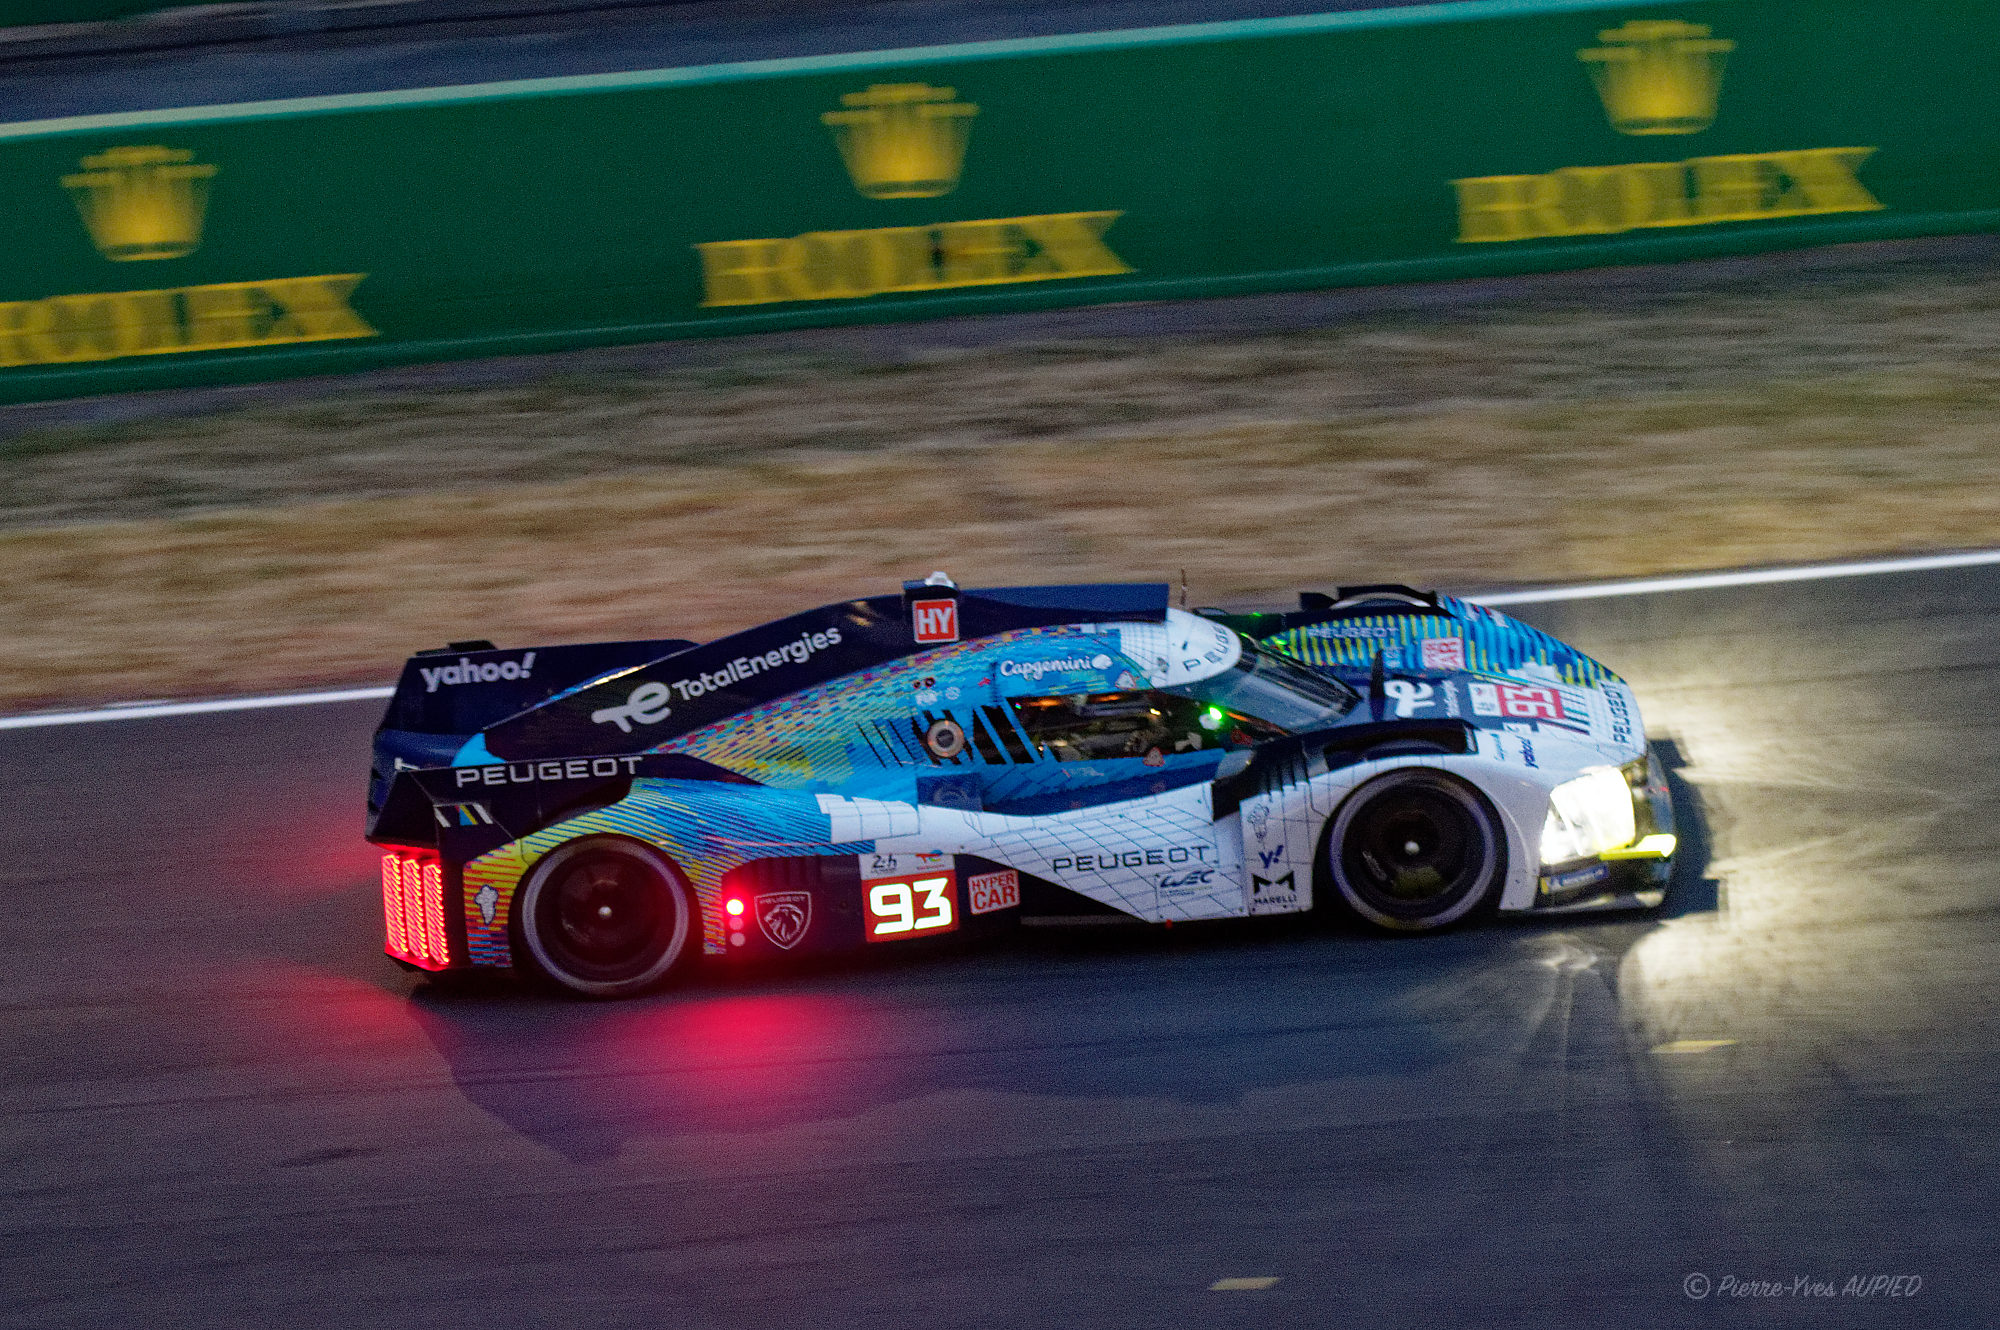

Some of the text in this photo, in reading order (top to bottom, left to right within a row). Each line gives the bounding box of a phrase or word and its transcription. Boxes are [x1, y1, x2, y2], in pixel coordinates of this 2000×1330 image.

[917, 606, 953, 635] HY
[419, 651, 537, 693] yahoo!
[671, 627, 842, 701] TotalEnergies
[1000, 655, 1092, 681] Capgemini
[1501, 686, 1559, 718] 93
[456, 756, 643, 788] PEUGEOT
[1053, 845, 1211, 873] PEUGEOT
[971, 873, 1015, 892] HYPER
[869, 877, 953, 935] 93
[973, 887, 1016, 910] CAR
